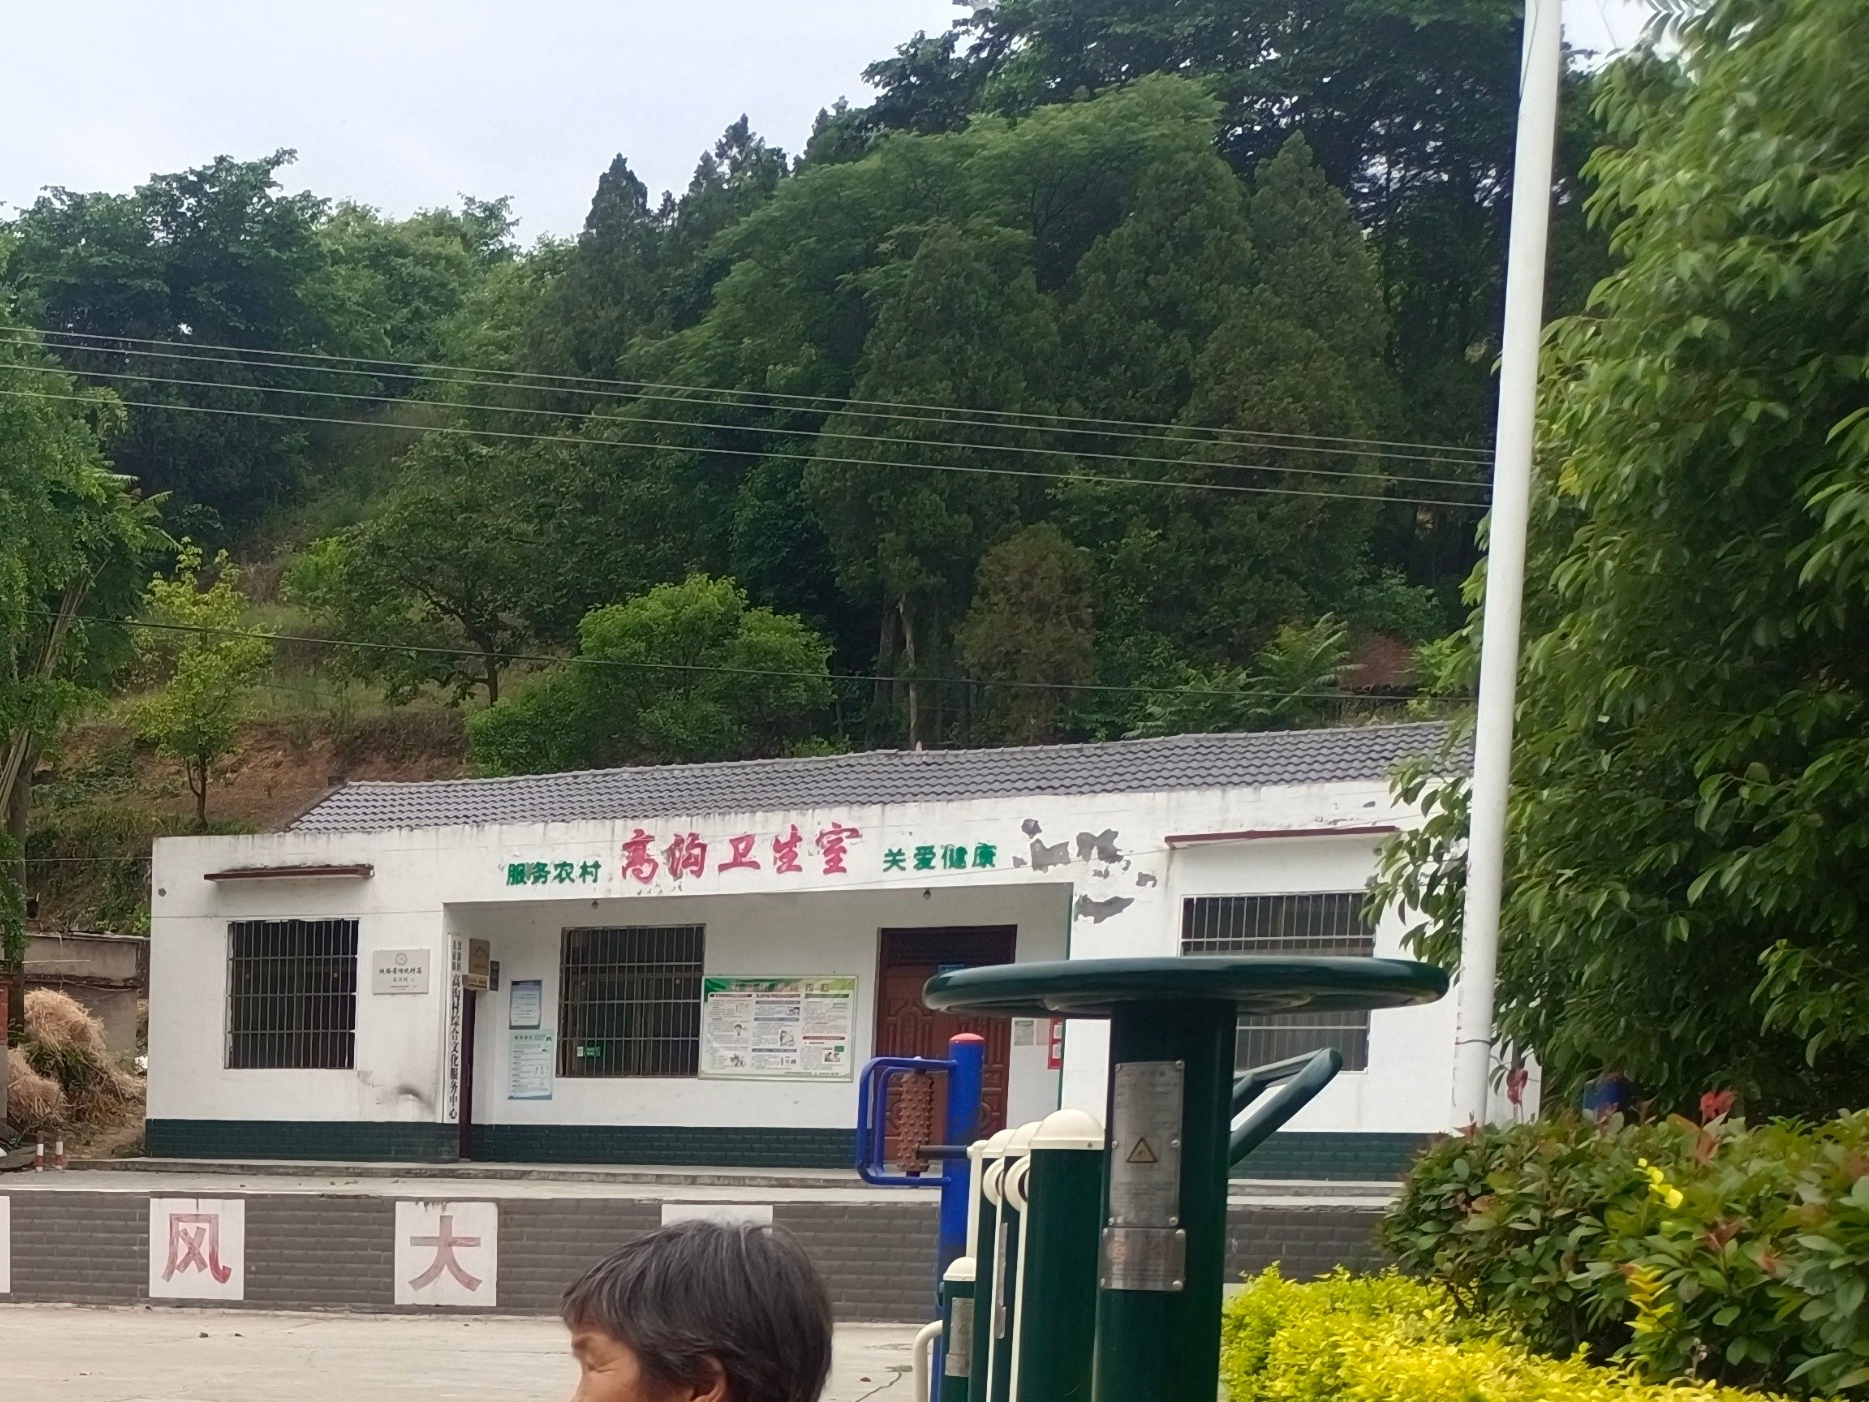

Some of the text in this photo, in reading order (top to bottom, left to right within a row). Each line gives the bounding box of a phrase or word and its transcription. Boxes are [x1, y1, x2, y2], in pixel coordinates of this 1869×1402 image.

[506, 860, 601, 886] 服务农村
[621, 822, 863, 885] 高沟卫生室
[883, 842, 997, 873] 关爱健康
[161, 1212, 232, 1285] 风
[408, 1214, 483, 1292] 大
